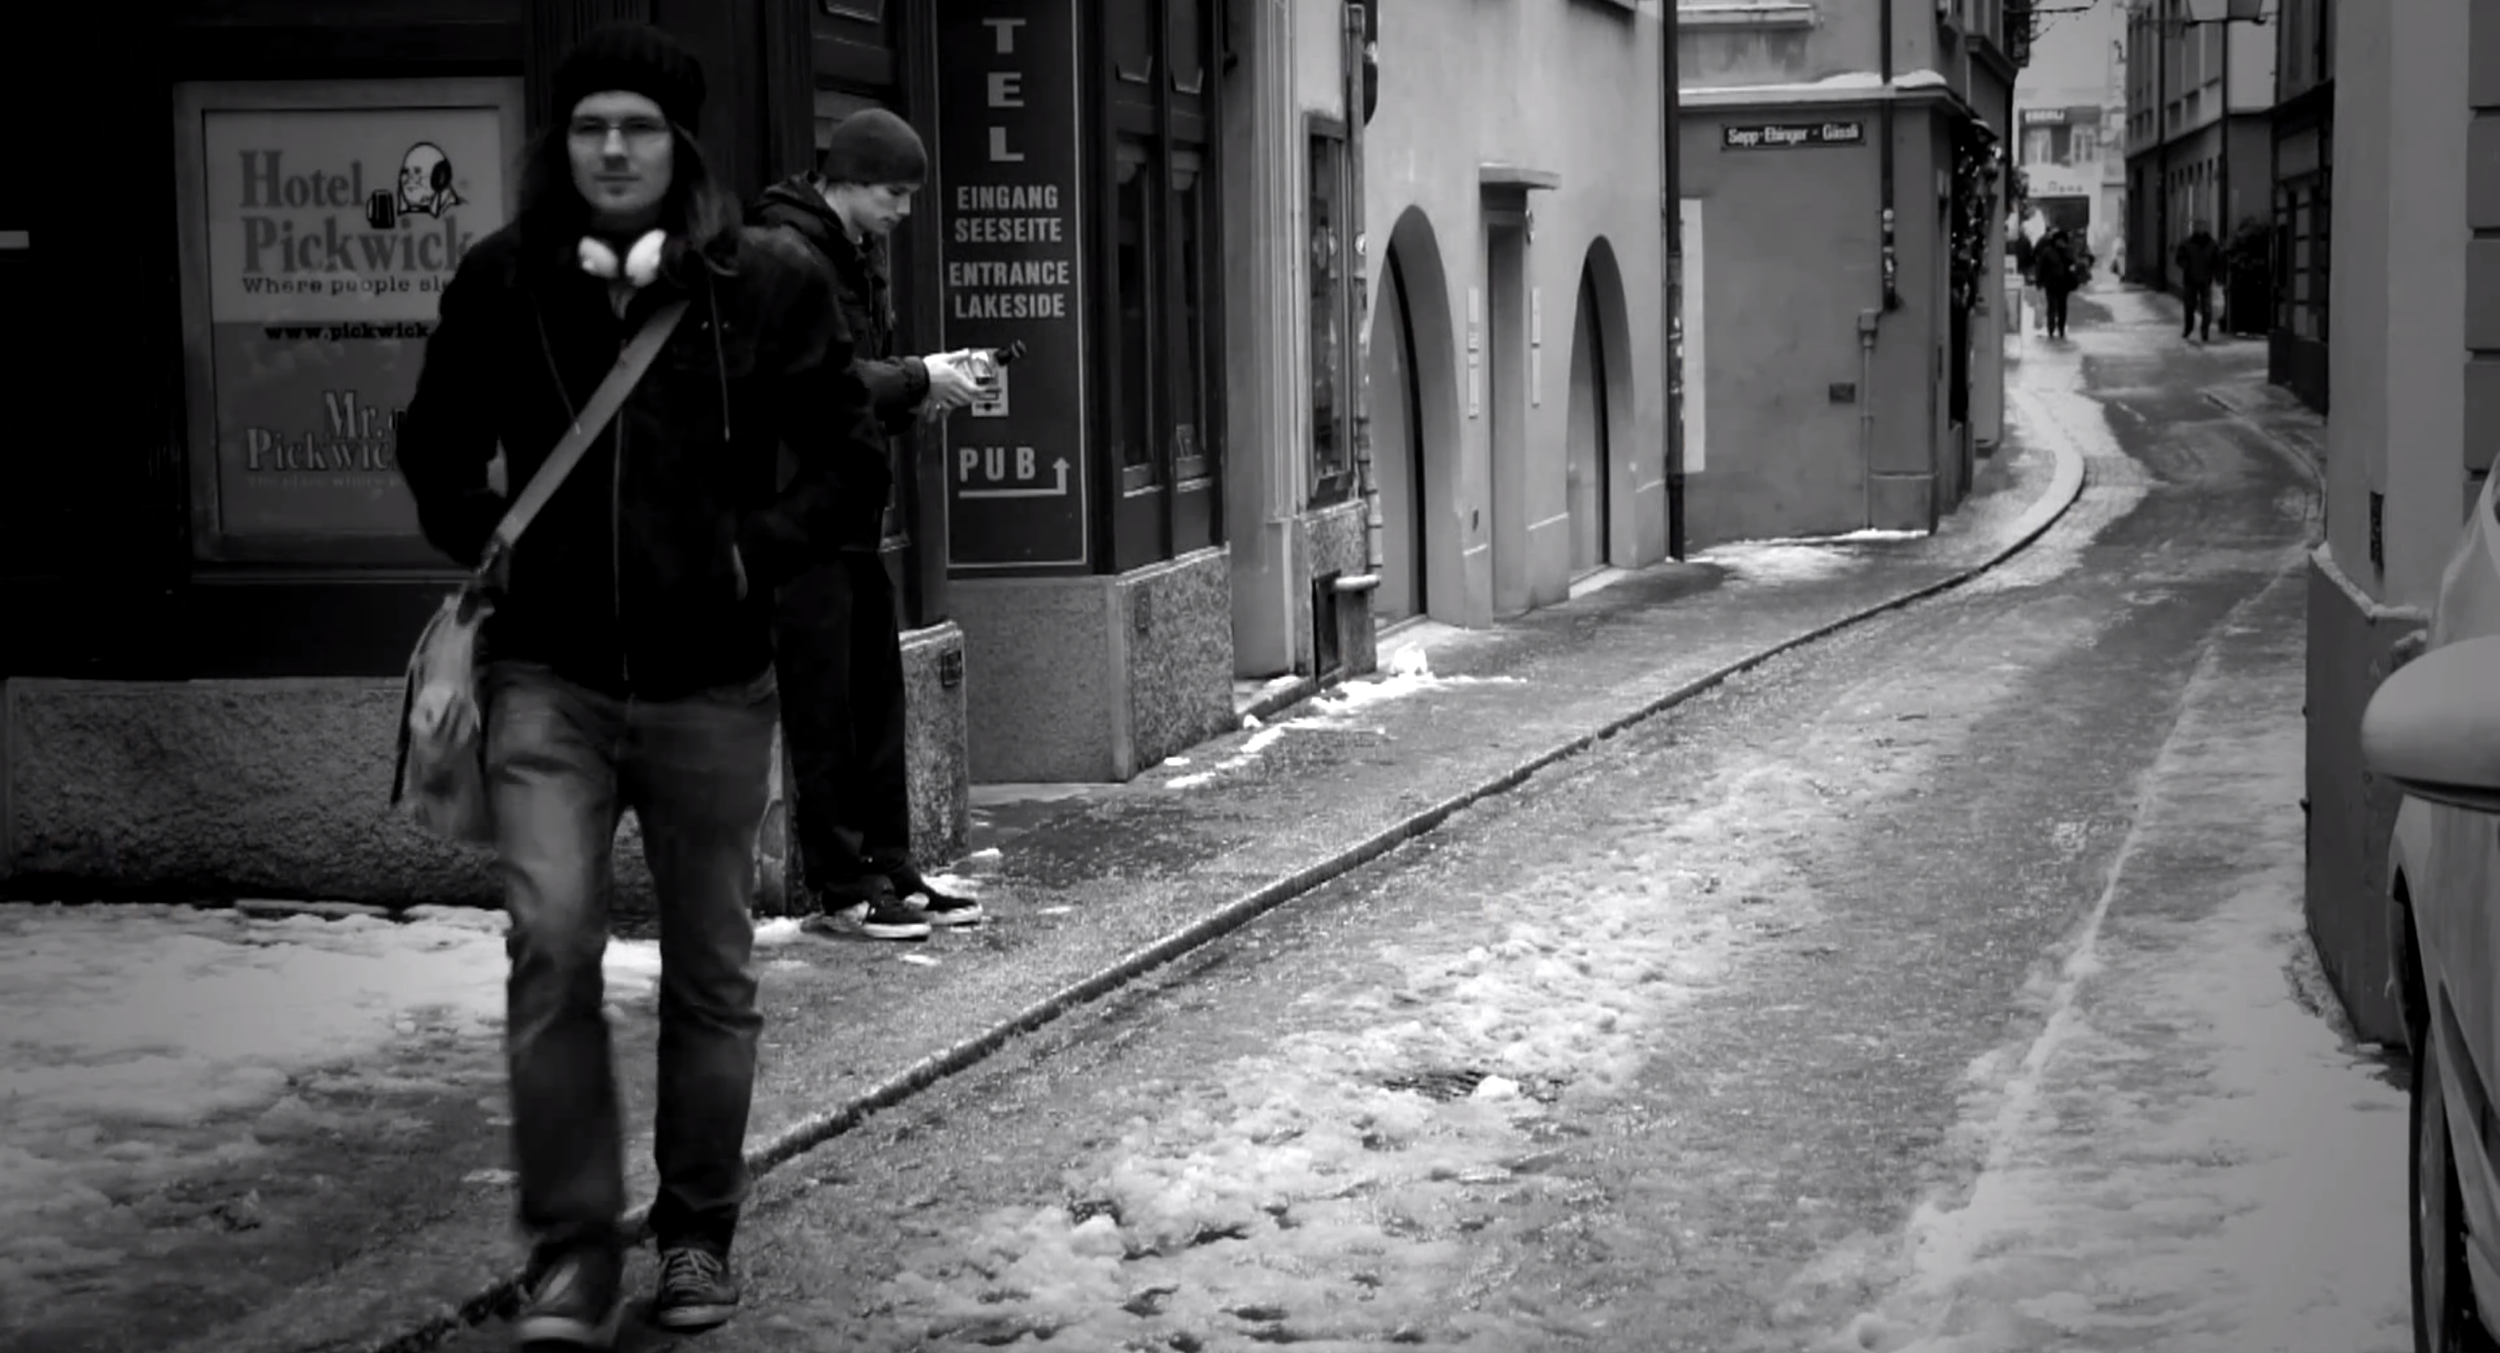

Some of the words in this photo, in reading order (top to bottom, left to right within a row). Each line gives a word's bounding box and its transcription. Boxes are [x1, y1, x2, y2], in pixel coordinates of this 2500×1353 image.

[239, 149, 364, 209] Hotel
[957, 185, 1058, 210] EINGANG
[240, 215, 476, 273] Pickwick
[955, 217, 1062, 243] SEESEITE
[242, 278, 323, 294] Where
[331, 277, 410, 297] people
[950, 261, 1069, 286] ENTRANCE
[955, 293, 1065, 318] LAKESIDE
[323, 390, 384, 440] Mr.
[245, 428, 398, 472] Pickwic
[958, 446, 1036, 483] PUB
